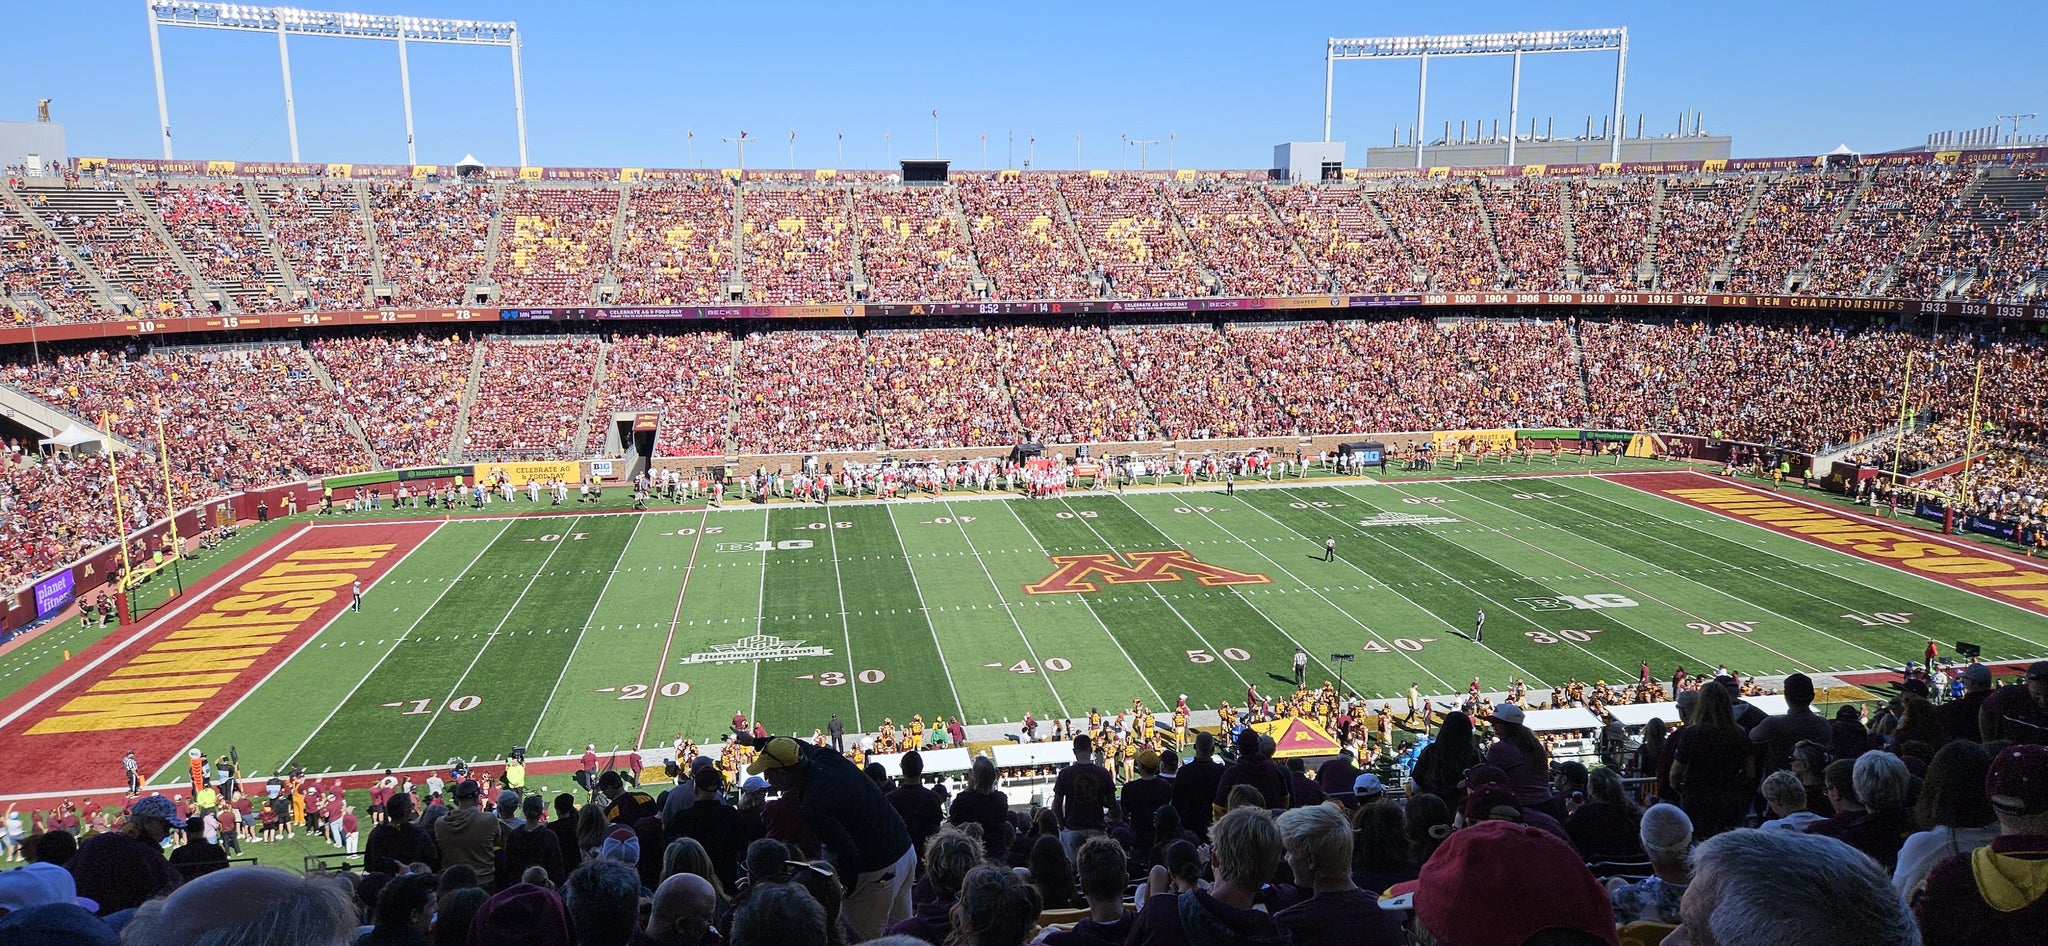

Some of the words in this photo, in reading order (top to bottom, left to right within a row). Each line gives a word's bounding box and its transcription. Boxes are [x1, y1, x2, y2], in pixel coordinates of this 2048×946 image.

[2001, 152, 2036, 160] GPHES
[1425, 295, 1447, 304] 1900
[1455, 295, 1477, 304] 1903
[1485, 294, 1508, 303] 1904
[1516, 294, 1540, 303] 1906
[1549, 294, 1572, 303] 1909
[1581, 294, 1605, 304] 1910
[1614, 294, 1639, 304] 1911
[1648, 295, 1673, 304] 1915
[1682, 296, 1708, 305] 1927
[1723, 296, 1747, 306] BIG
[1756, 297, 1780, 306] TEN
[1790, 298, 1905, 311] CHAMPIONSHIPS
[929, 305, 936, 314] 7
[980, 303, 999, 314] 8:52
[1040, 303, 1049, 313] 14
[1052, 303, 1062, 313] R
[1920, 302, 1948, 313] 1933
[1961, 303, 1987, 315] 1934
[1996, 305, 2024, 318] 1935
[303, 314, 319, 324] 54
[380, 311, 395, 322] 72
[456, 310, 470, 320] 78
[519, 311, 530, 319] MN
[139, 322, 154, 333] 10
[222, 317, 238, 328] 15
[1790, 454, 1801, 465] 25
[416, 469, 449, 478] Huntington
[516, 465, 553, 474] CELEBRATE
[1173, 506, 1214, 514] 40
[1289, 501, 1333, 509] 30
[934, 515, 978, 524] 40
[1055, 511, 1099, 520] 50
[676, 526, 725, 536] 20
[808, 521, 854, 530] 30
[540, 532, 591, 542] 10
[1020, 550, 1275, 596] M
[37, 576, 67, 605] planet
[1839, 612, 1911, 627] 10
[1685, 620, 1755, 636] 20
[21, 543, 398, 736] MINNESOTA
[1524, 629, 1593, 644] 30
[1362, 637, 1425, 653] 40
[780, 647, 817, 656] Bank
[1185, 647, 1253, 664] 50
[1008, 657, 1074, 675] 40
[817, 669, 887, 688] 30
[616, 681, 691, 701] 20
[401, 695, 484, 716] 10
